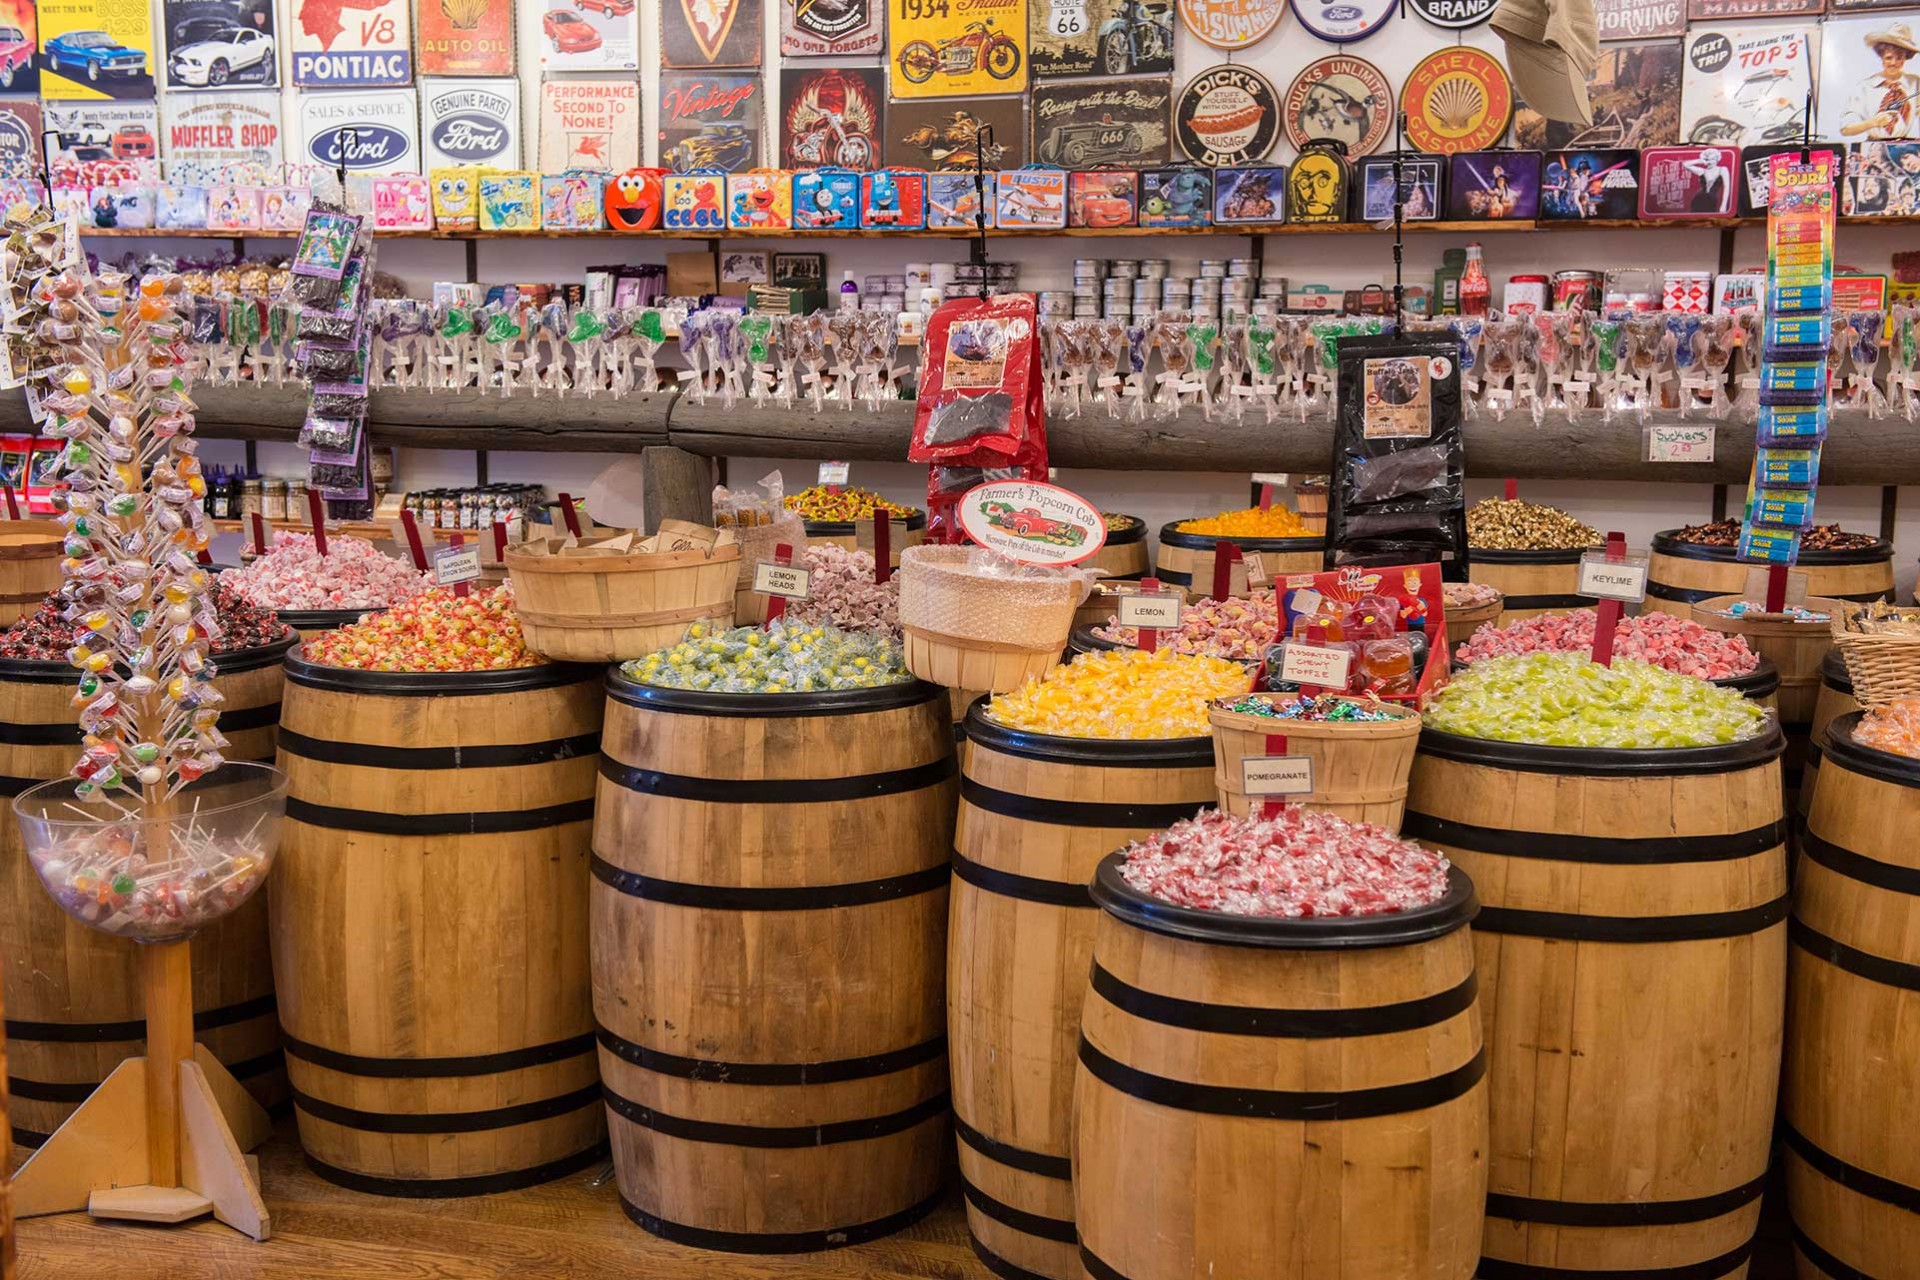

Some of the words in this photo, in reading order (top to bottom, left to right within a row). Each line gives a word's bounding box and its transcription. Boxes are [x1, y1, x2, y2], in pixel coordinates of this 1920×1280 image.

[95, 0, 148, 17] BOSS
[902, 0, 950, 20] 1934
[1328, 7, 1356, 20] Ford
[1428, 0, 1490, 19] BRAND
[361, 13, 396, 47] V8
[1057, 17, 1080, 33] 66
[424, 39, 473, 53] AUTO
[478, 39, 508, 53] OIL
[803, 40, 826, 53] ONE
[829, 33, 879, 53] FORGETS
[1692, 37, 1726, 58] NEXT
[1697, 50, 1728, 69] TRIP
[1739, 46, 1783, 69] TOP
[298, 55, 405, 79] PONTIAC
[1417, 55, 1493, 86] SHELL
[547, 84, 635, 98] PERFORMANCE
[1193, 71, 1261, 97] DICK'S
[1290, 68, 1324, 111] DUCKS
[1331, 61, 1387, 110] UNLIMITED
[435, 94, 476, 114] GENUINE
[479, 95, 507, 114] PARTS
[553, 100, 604, 113] SECOND
[662, 82, 756, 121] Vintage
[1039, 98, 1078, 116] Racing
[1078, 92, 1103, 107] with
[1105, 91, 1123, 105] the
[309, 106, 345, 119] SALES
[358, 103, 405, 116] SERVICE
[171, 125, 235, 148] MUFFLER
[241, 124, 277, 147] SHOP
[439, 119, 502, 151] Ford
[1101, 130, 1124, 144] 666
[1205, 135, 1248, 148] SAUSAGE
[1410, 115, 1502, 155] GASOLINE
[328, 130, 389, 160] Ford
[1201, 149, 1249, 167] DELI
[1012, 174, 1062, 187] DUSTY
[674, 195, 691, 206] too
[1367, 368, 1396, 376] Buffalo
[1656, 428, 1708, 442] Suckers
[979, 487, 1025, 502] Farmer's
[1028, 490, 1074, 516] Popcorn
[1076, 507, 1096, 527] Cob
[769, 571, 797, 581] LEMON
[1591, 574, 1633, 586] KEYLIME
[768, 580, 795, 590] HEADS
[1135, 608, 1165, 616] LEMON
[1288, 649, 1341, 661] ASSORTED
[1296, 659, 1330, 669] CHEWY
[1288, 668, 1329, 679] TOFFEE
[1247, 771, 1308, 781] POMEGRANATE
